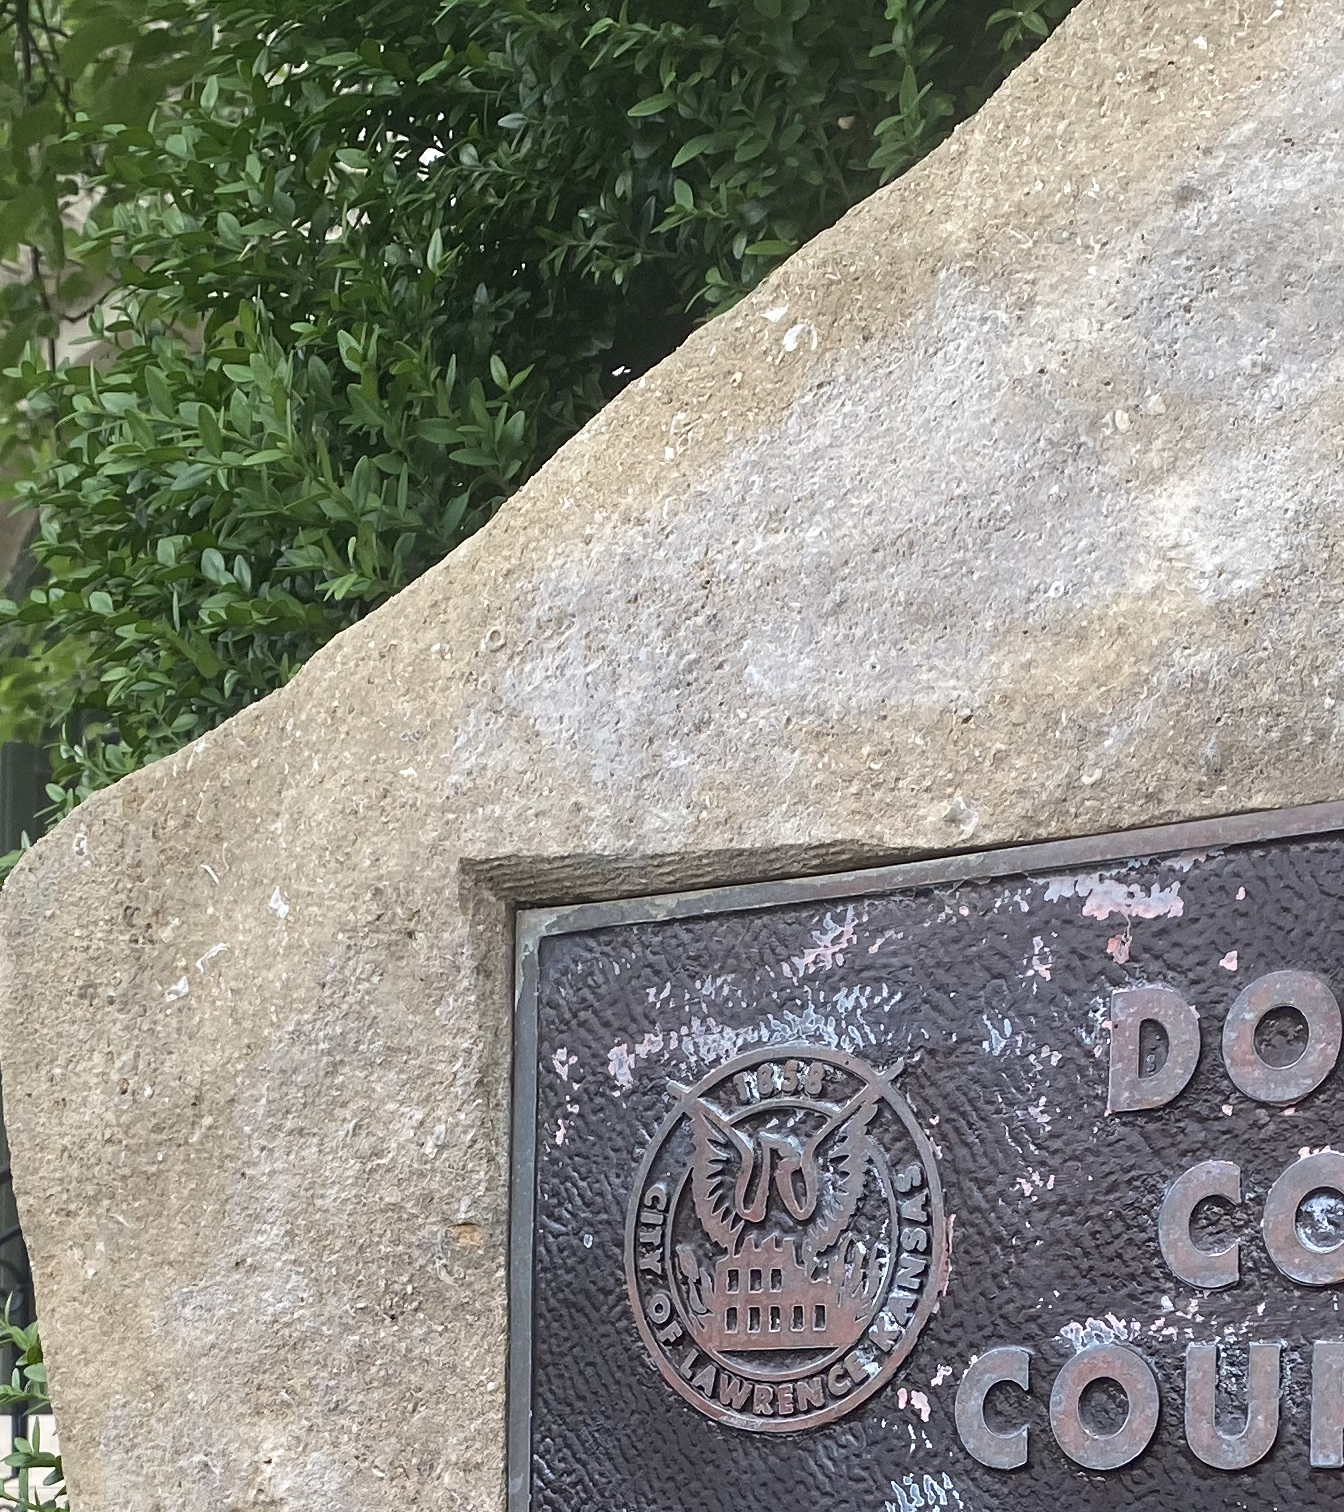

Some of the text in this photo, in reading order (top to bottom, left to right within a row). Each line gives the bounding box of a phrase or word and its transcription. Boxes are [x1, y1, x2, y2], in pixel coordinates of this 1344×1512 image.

[733, 1059, 827, 1100] 1858
[638, 1162, 928, 1416] CITY OF LAWRENCE KANSAS
